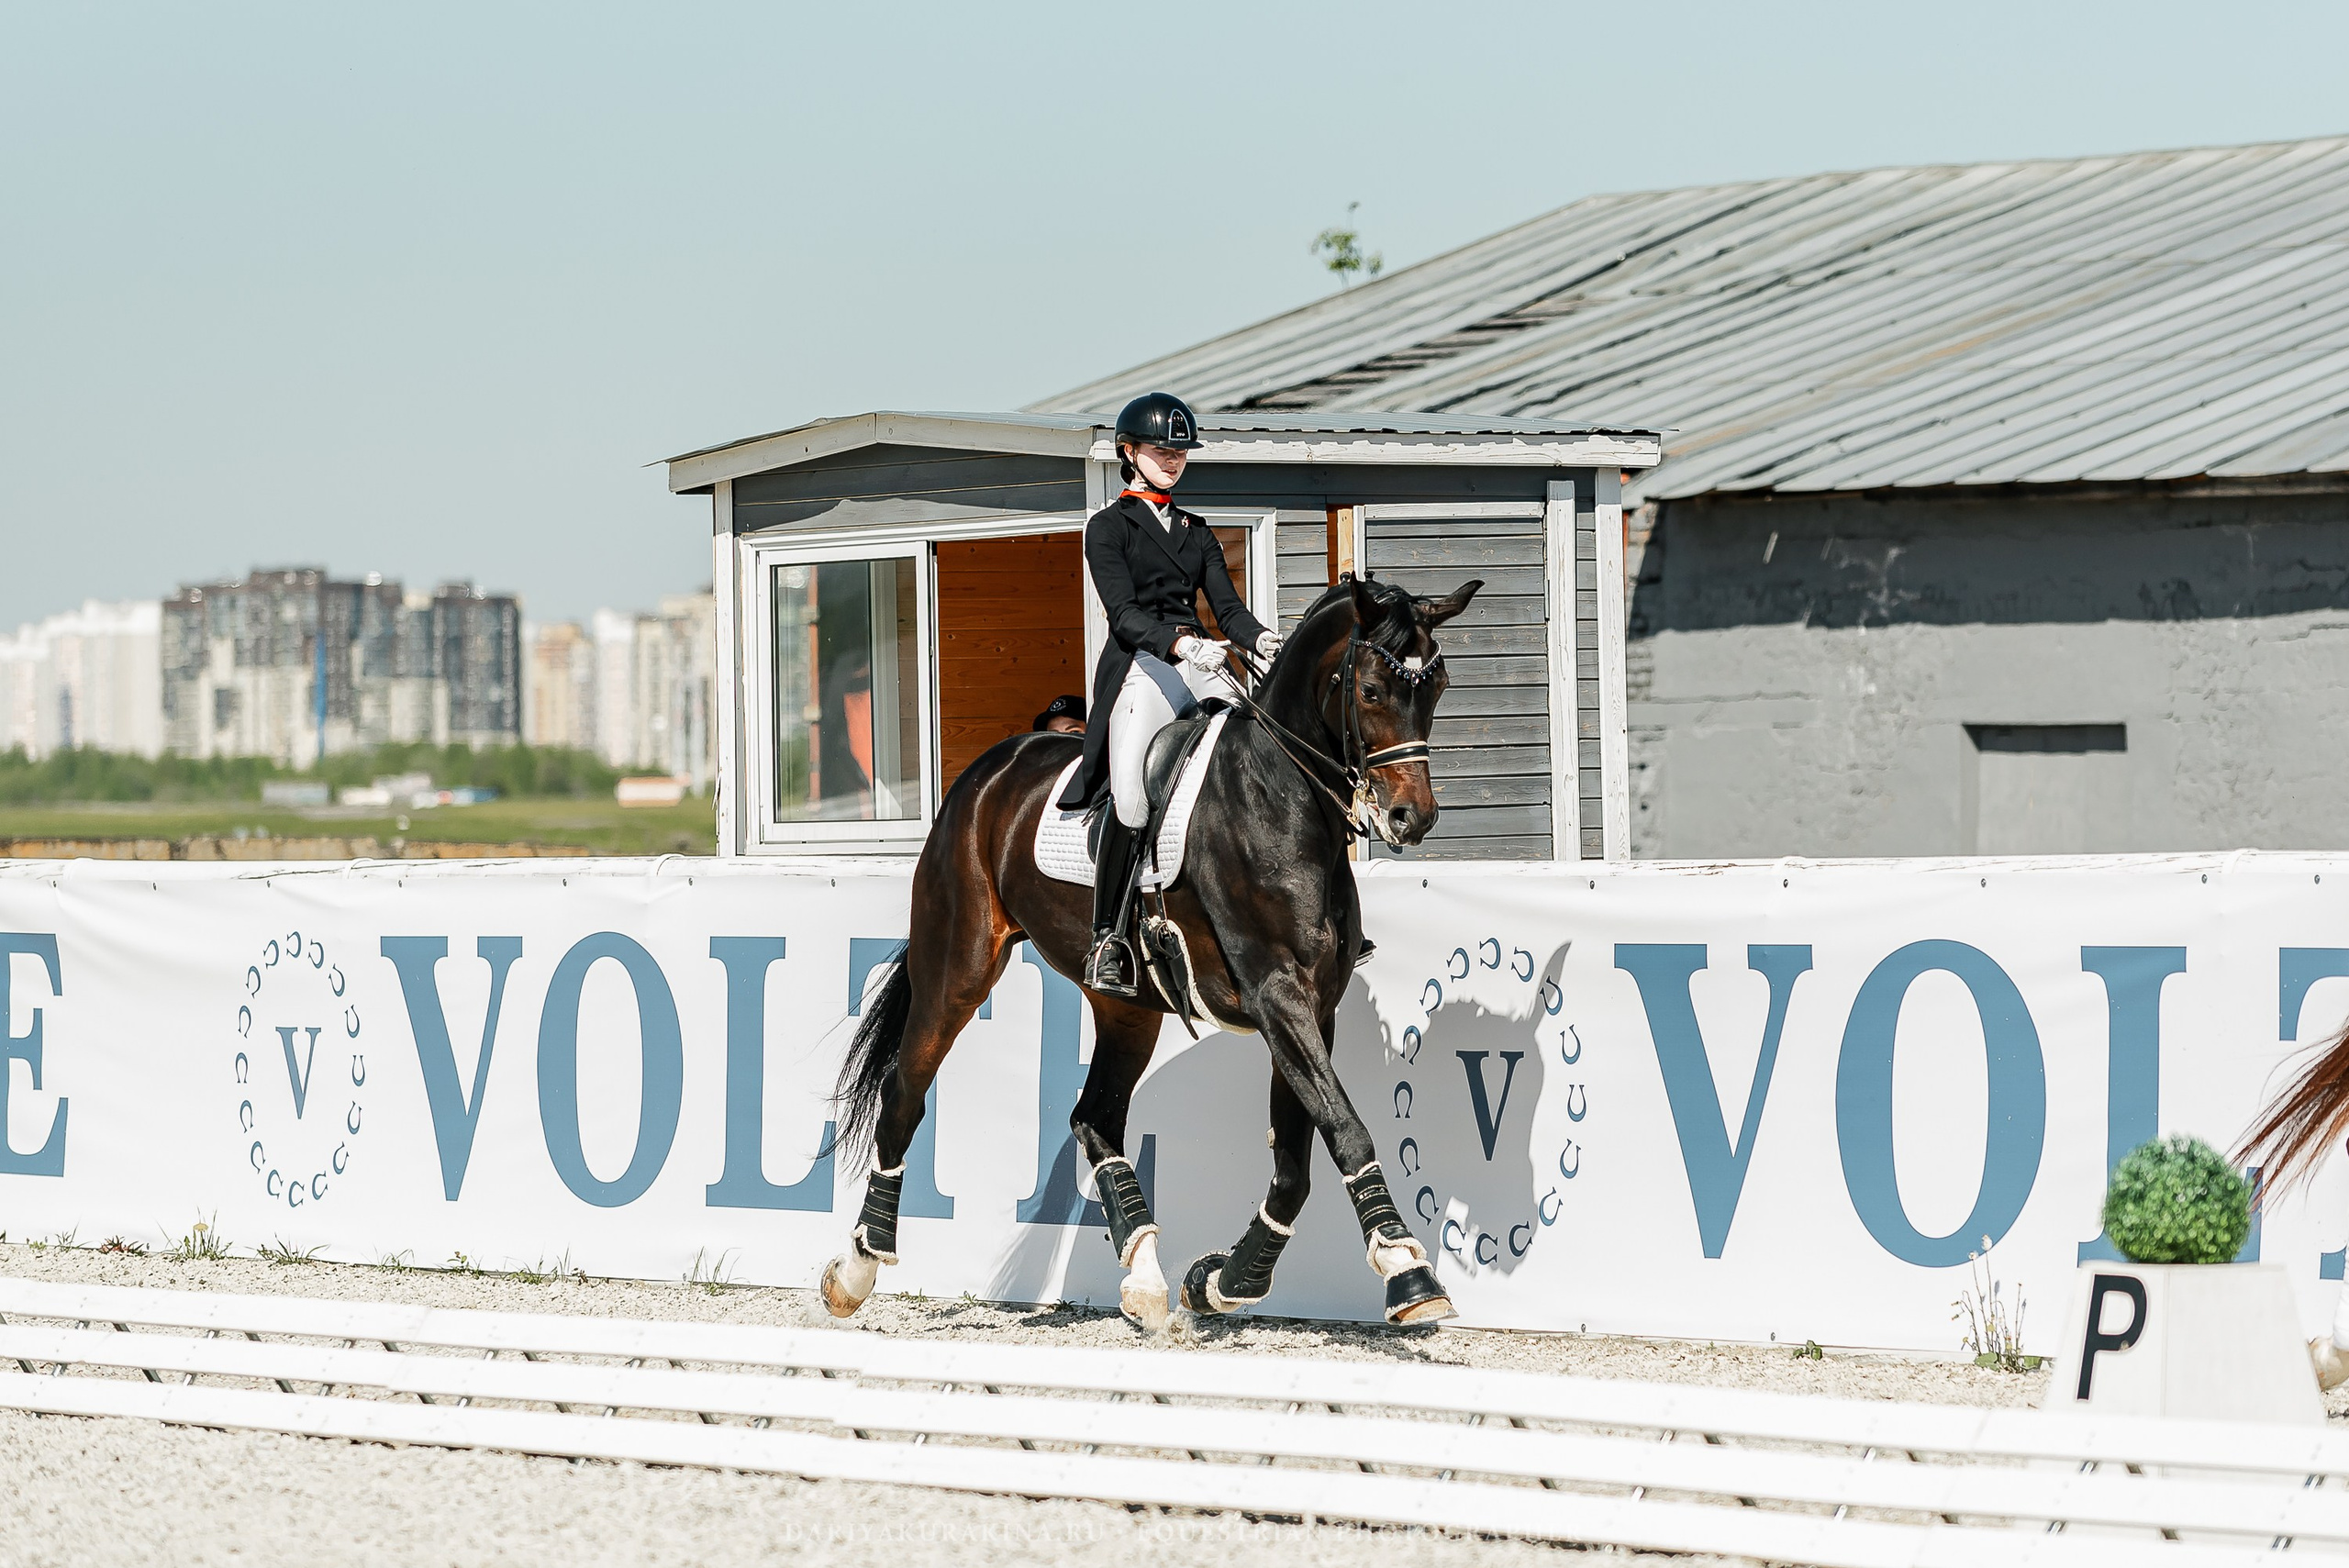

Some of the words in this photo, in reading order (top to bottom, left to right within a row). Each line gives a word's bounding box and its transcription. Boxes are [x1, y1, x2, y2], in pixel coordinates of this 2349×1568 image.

[275, 1026, 322, 1120] V
[1456, 1051, 1524, 1162] V
[2076, 1273, 2148, 1401] P
